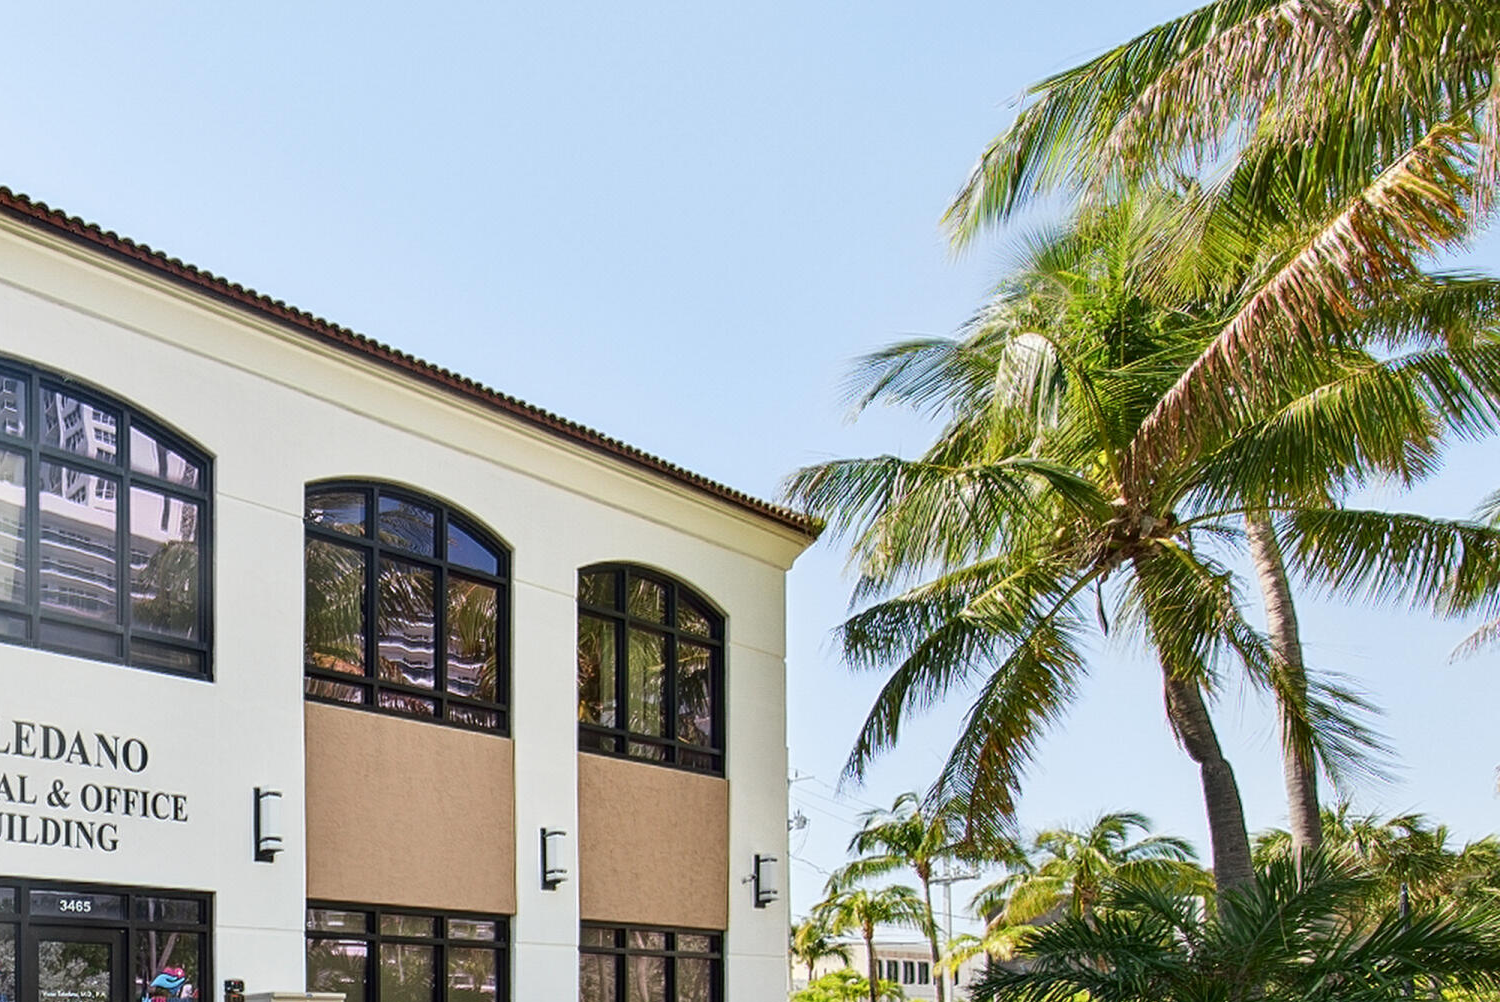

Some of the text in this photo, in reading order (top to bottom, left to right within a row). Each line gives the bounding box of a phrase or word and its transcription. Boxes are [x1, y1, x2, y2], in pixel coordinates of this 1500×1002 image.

[47, 779, 71, 809] &
[80, 783, 189, 822] OFFICE
[60, 899, 91, 913] 3465
